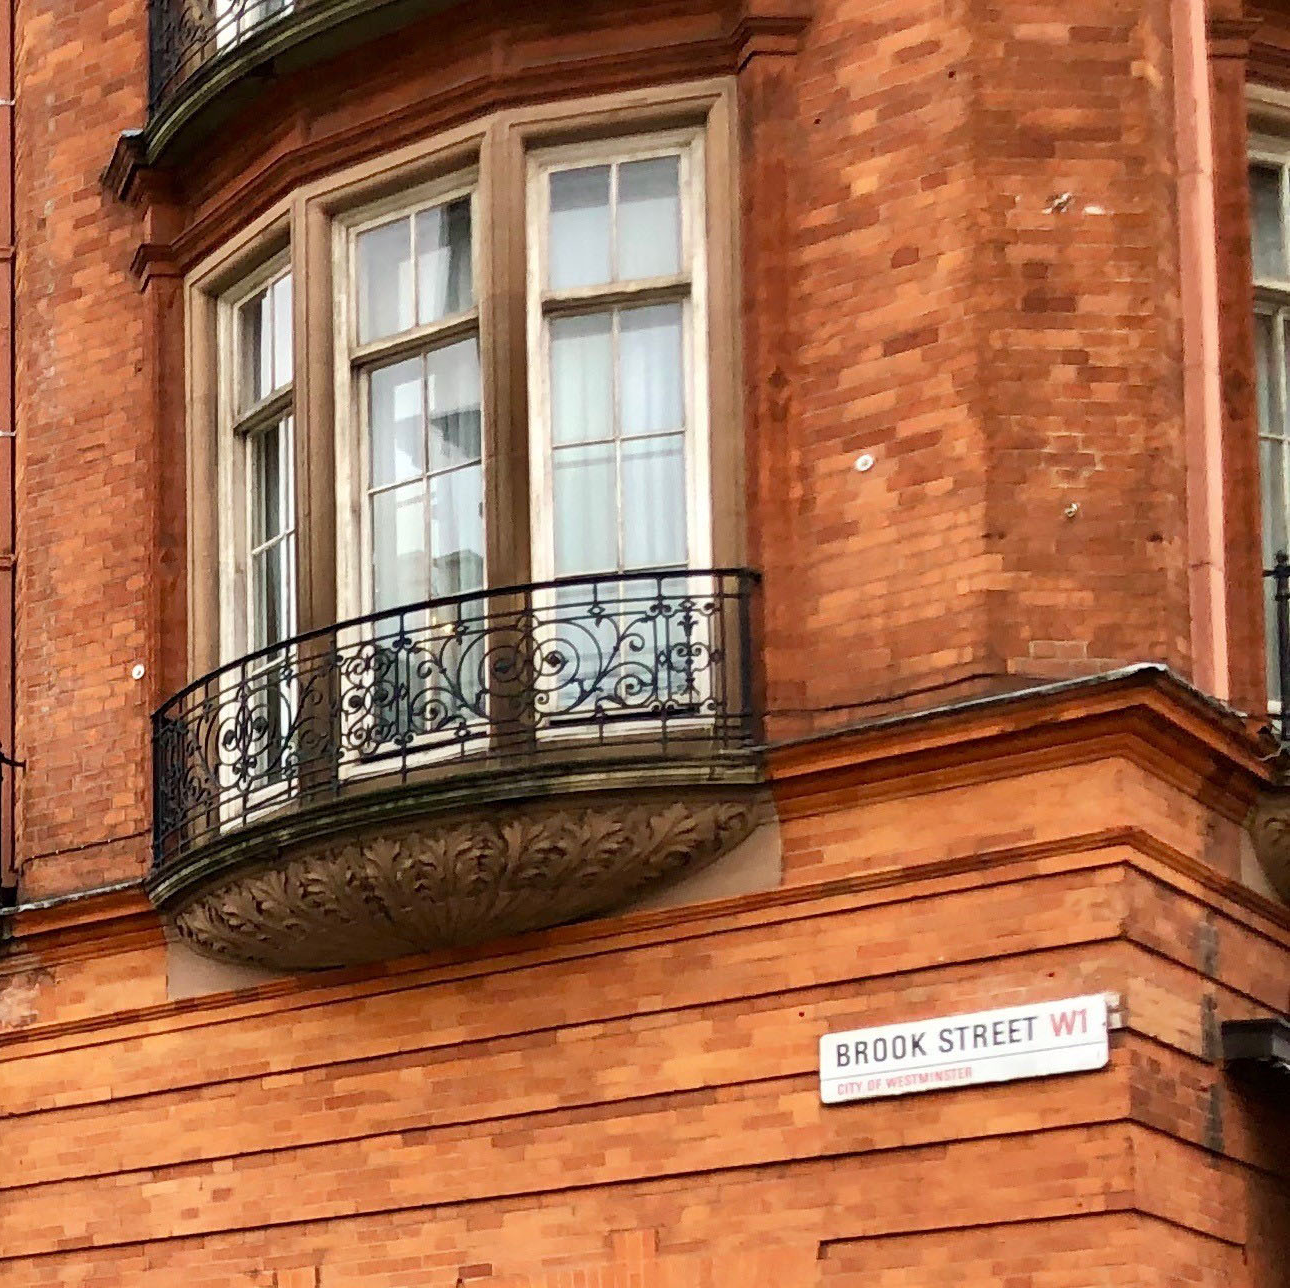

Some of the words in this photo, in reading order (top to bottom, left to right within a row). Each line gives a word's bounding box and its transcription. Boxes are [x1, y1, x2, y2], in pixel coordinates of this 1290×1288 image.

[836, 1032, 927, 1068] BROOK
[938, 1016, 1039, 1053] STREET
[1049, 1008, 1088, 1037] W1
[837, 1081, 862, 1096] CITY
[867, 1079, 881, 1091] OF
[886, 1067, 972, 1089] WESTMINSTER
